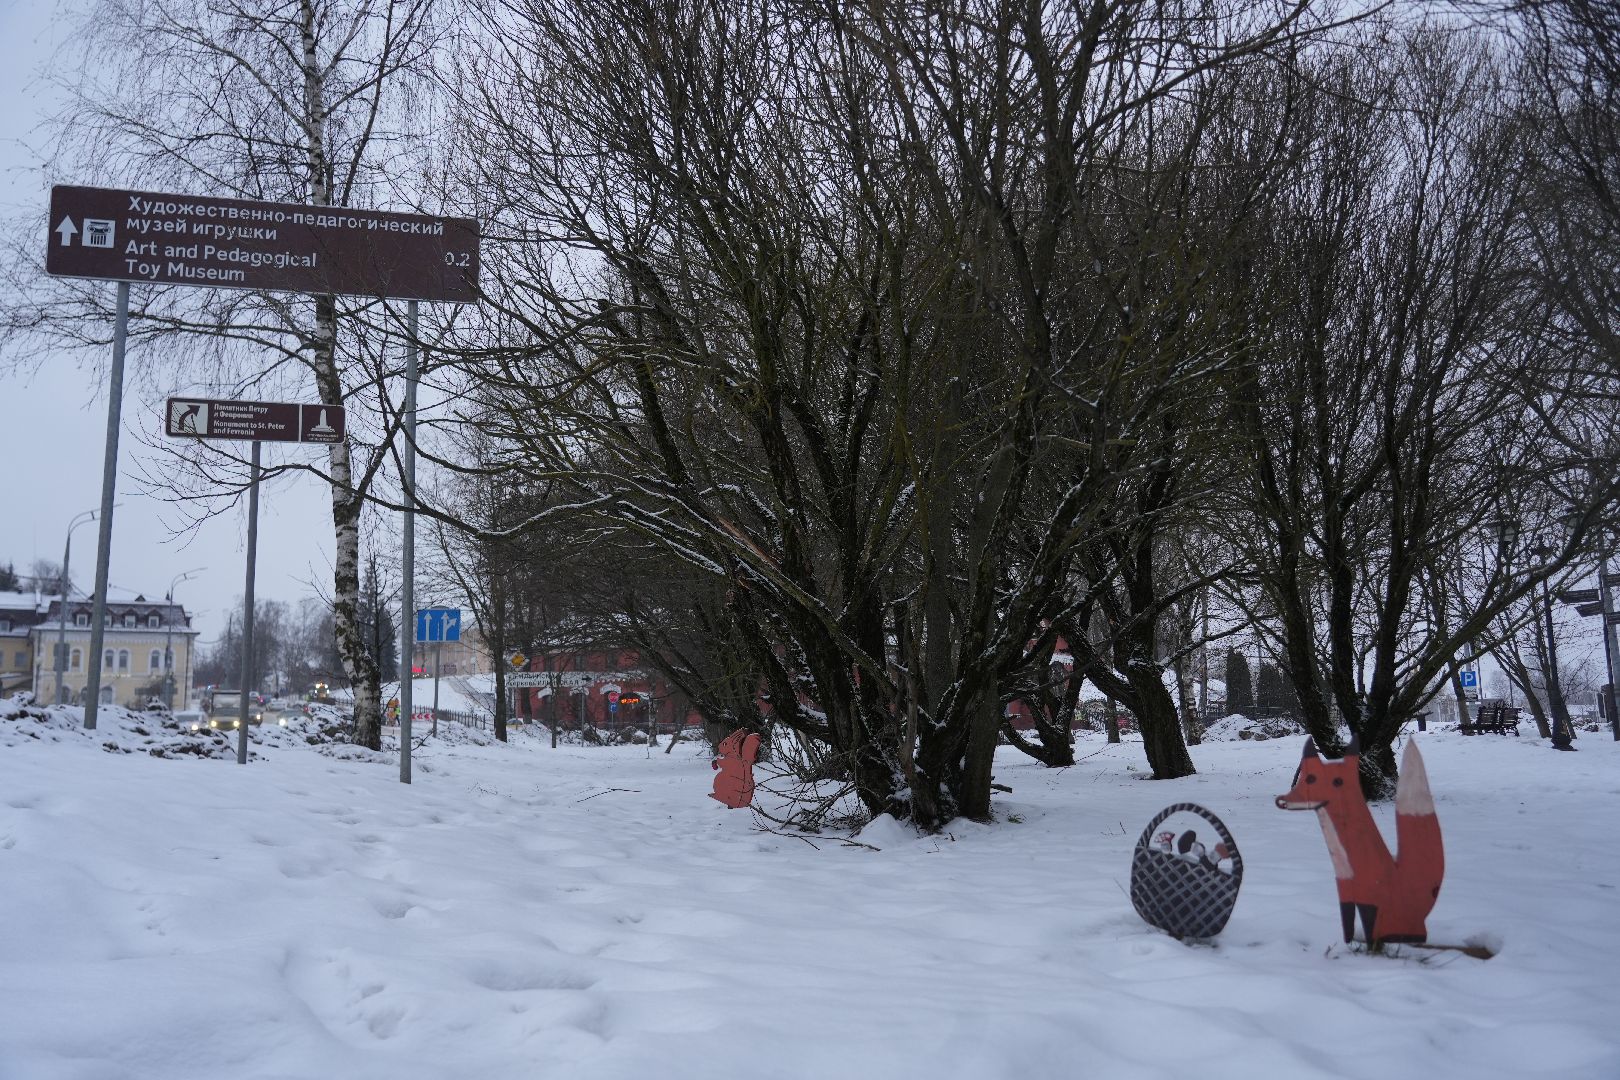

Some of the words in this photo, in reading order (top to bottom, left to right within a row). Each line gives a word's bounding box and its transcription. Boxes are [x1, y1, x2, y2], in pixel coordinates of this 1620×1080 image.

[128, 196, 443, 235] Художественно-педагогический
[126, 218, 187, 234] музей
[193, 223, 277, 240] игрушки
[125, 240, 158, 256] Art
[164, 245, 198, 259] and
[204, 245, 317, 269] Pedagogical
[444, 252, 470, 267] 0.2
[125, 259, 161, 279] Toy
[167, 262, 245, 281] Museum
[214, 404, 247, 412] Памятник
[248, 405, 269, 413] Петру
[213, 420, 249, 428] Monument
